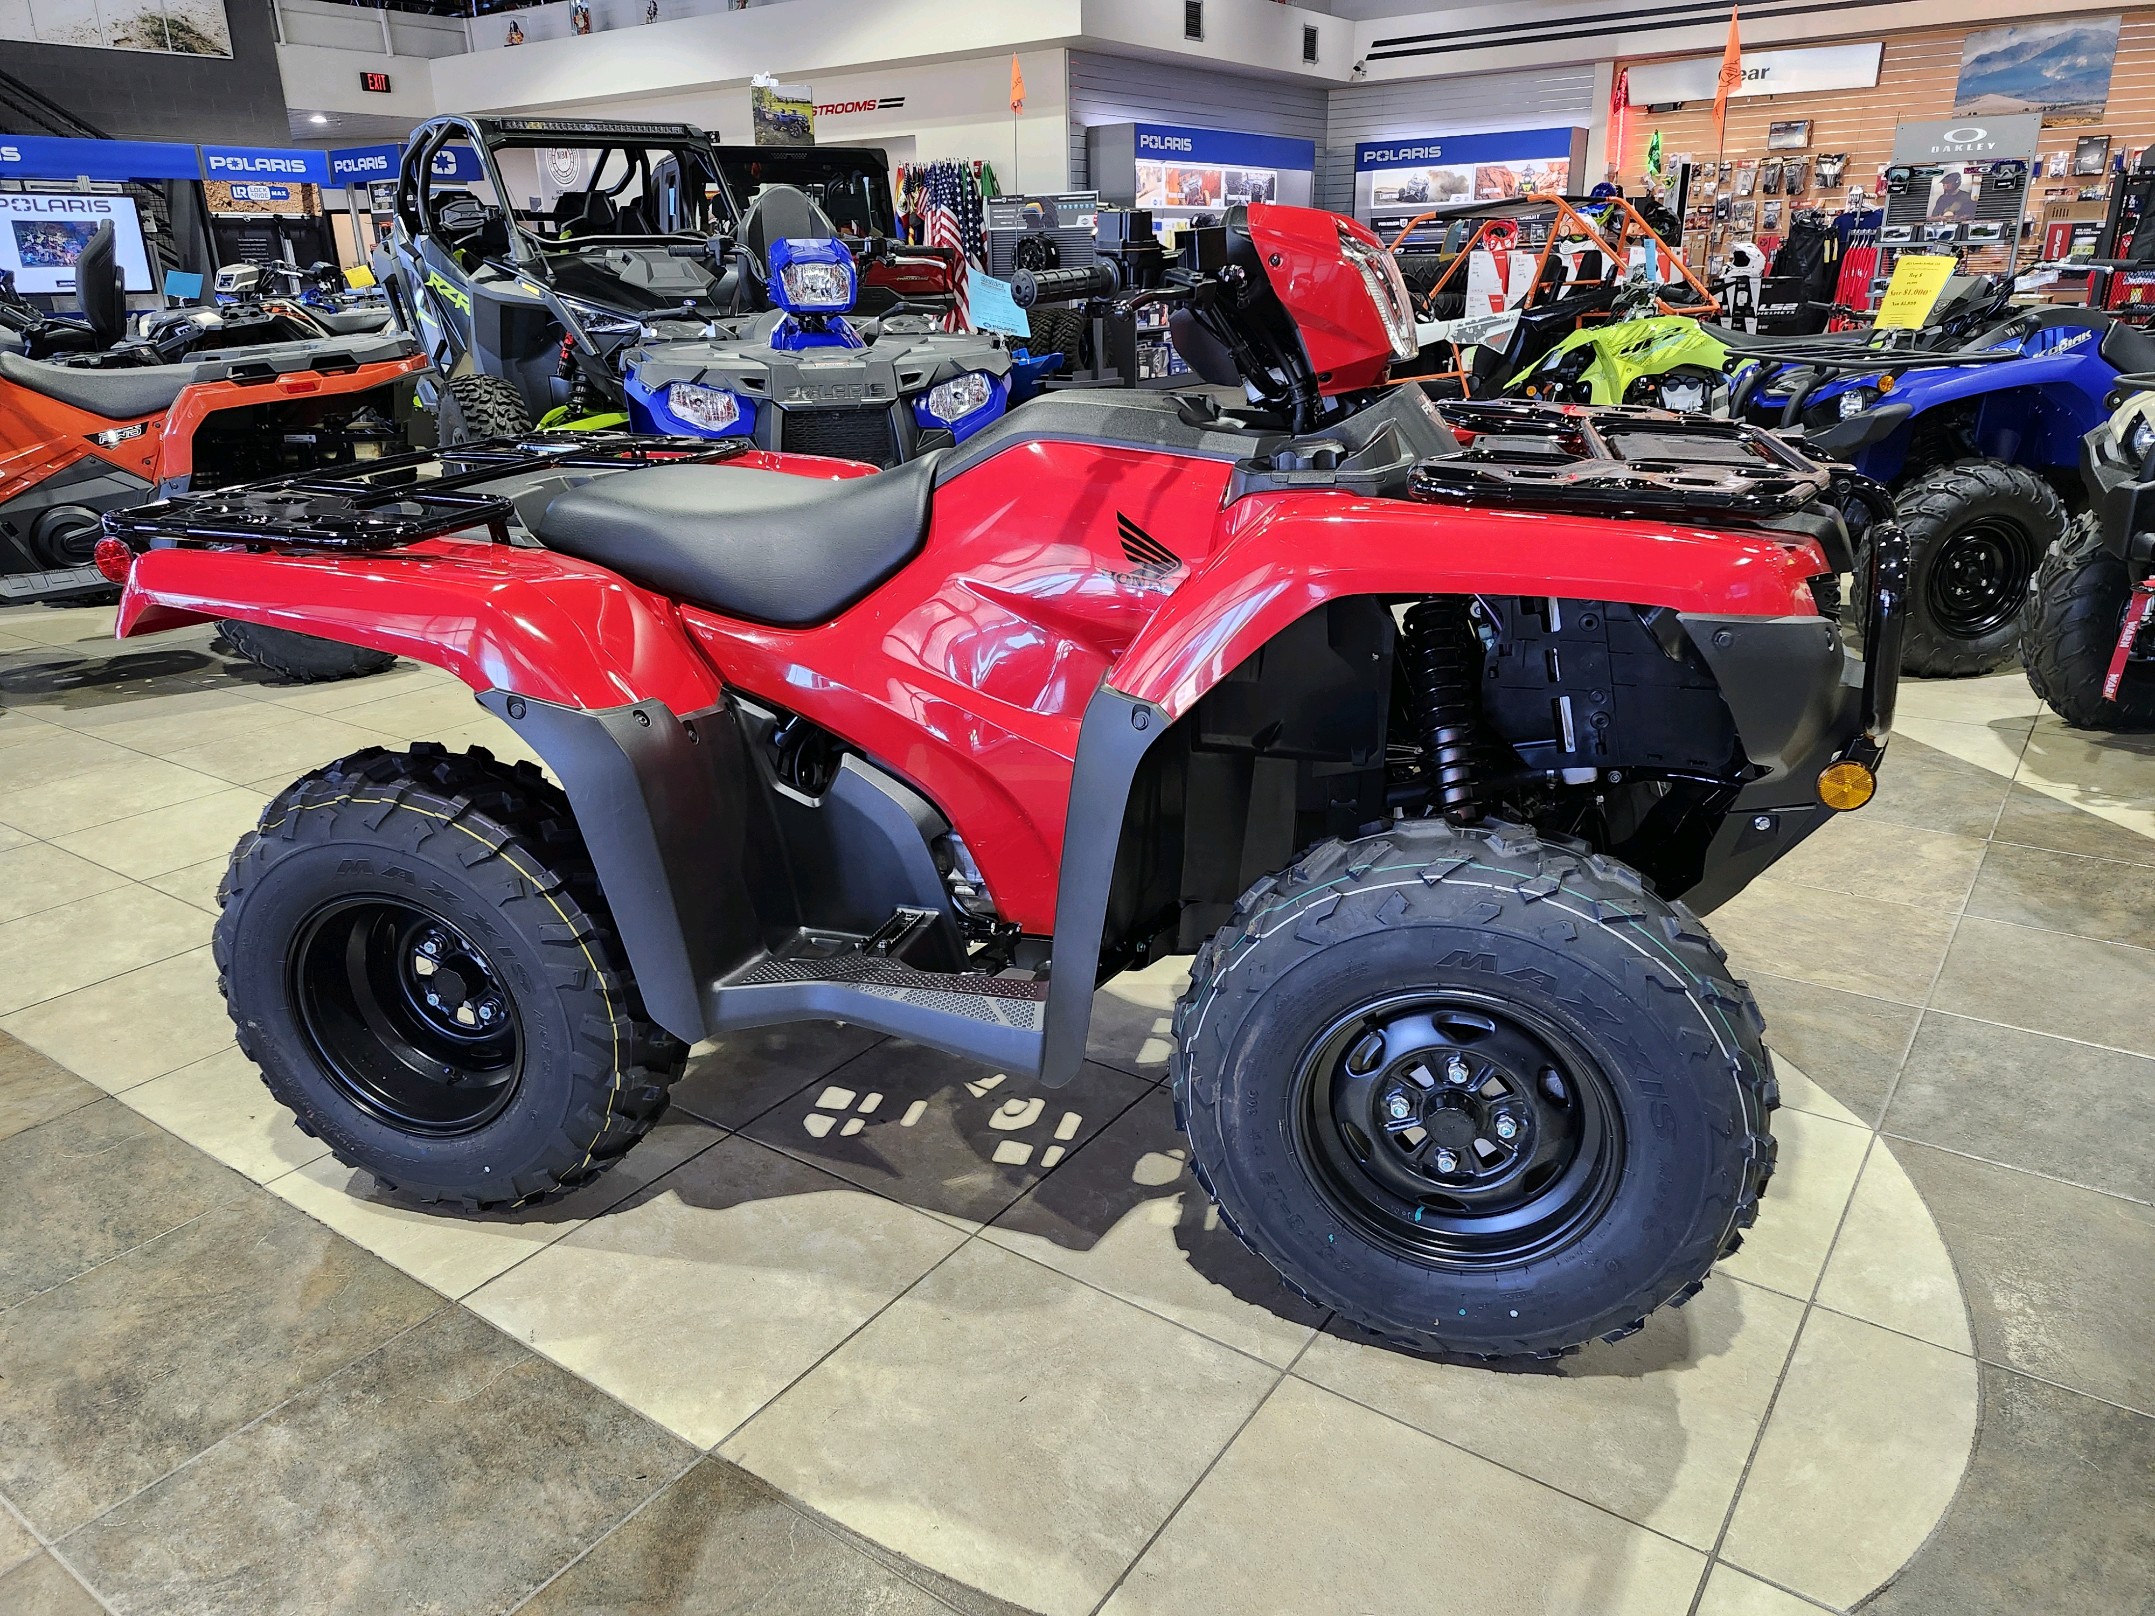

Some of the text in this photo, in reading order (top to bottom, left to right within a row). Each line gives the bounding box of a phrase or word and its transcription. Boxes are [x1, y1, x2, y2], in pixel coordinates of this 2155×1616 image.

[367, 73, 387, 91] EXIT
[1719, 67, 1770, 81] ear
[812, 100, 877, 116] STROOMS
[1140, 134, 1193, 152] POLARIS
[1931, 142, 1996, 153] OAKLEY
[1363, 145, 1442, 163] POLARIS
[209, 156, 307, 173] POLARIS
[333, 155, 388, 173] POLARIS
[0, 198, 111, 213] POLARIS
[425, 270, 471, 317] RZR
[1758, 302, 1799, 311] LS2
[784, 383, 887, 400] POLARIS
[2119, 620, 2139, 648] WARN
[336, 858, 536, 995] MAXXIS
[1434, 948, 1680, 1146] MAXXIS
